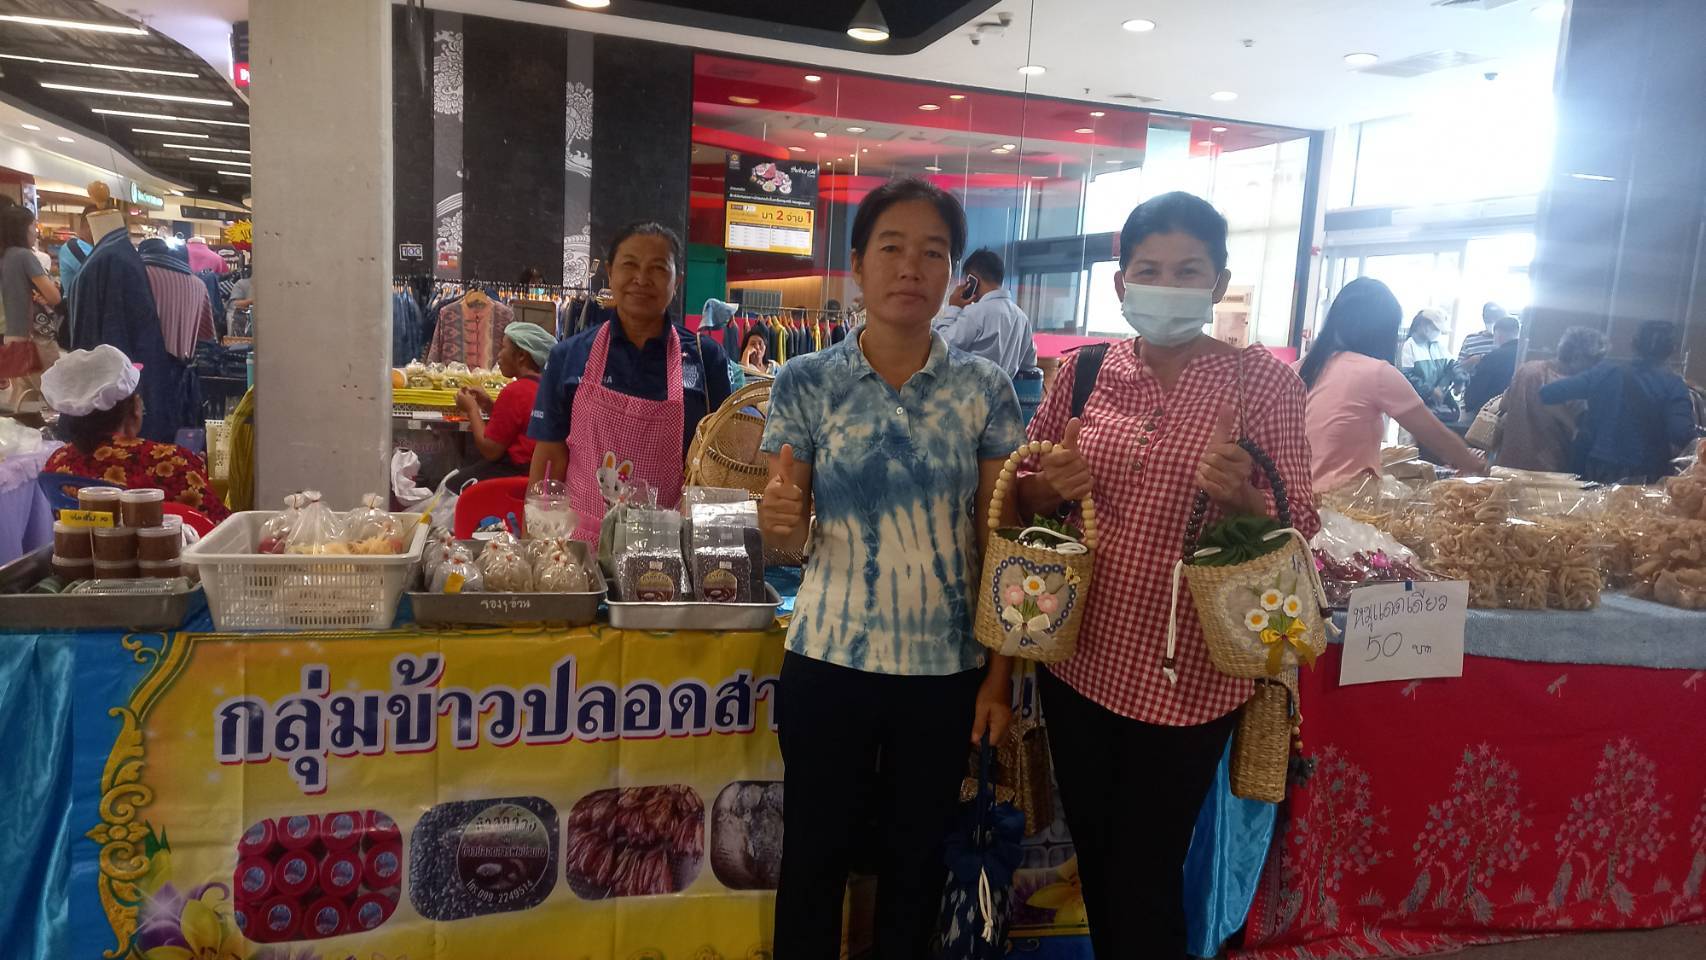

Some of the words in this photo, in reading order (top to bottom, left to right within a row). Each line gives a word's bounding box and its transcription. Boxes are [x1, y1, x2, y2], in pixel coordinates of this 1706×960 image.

[761, 211, 773, 220] มา
[776, 209, 784, 221] 2
[786, 212, 804, 223] จ่าย
[805, 210, 812, 224] 1
[1365, 632, 1403, 662] 50
